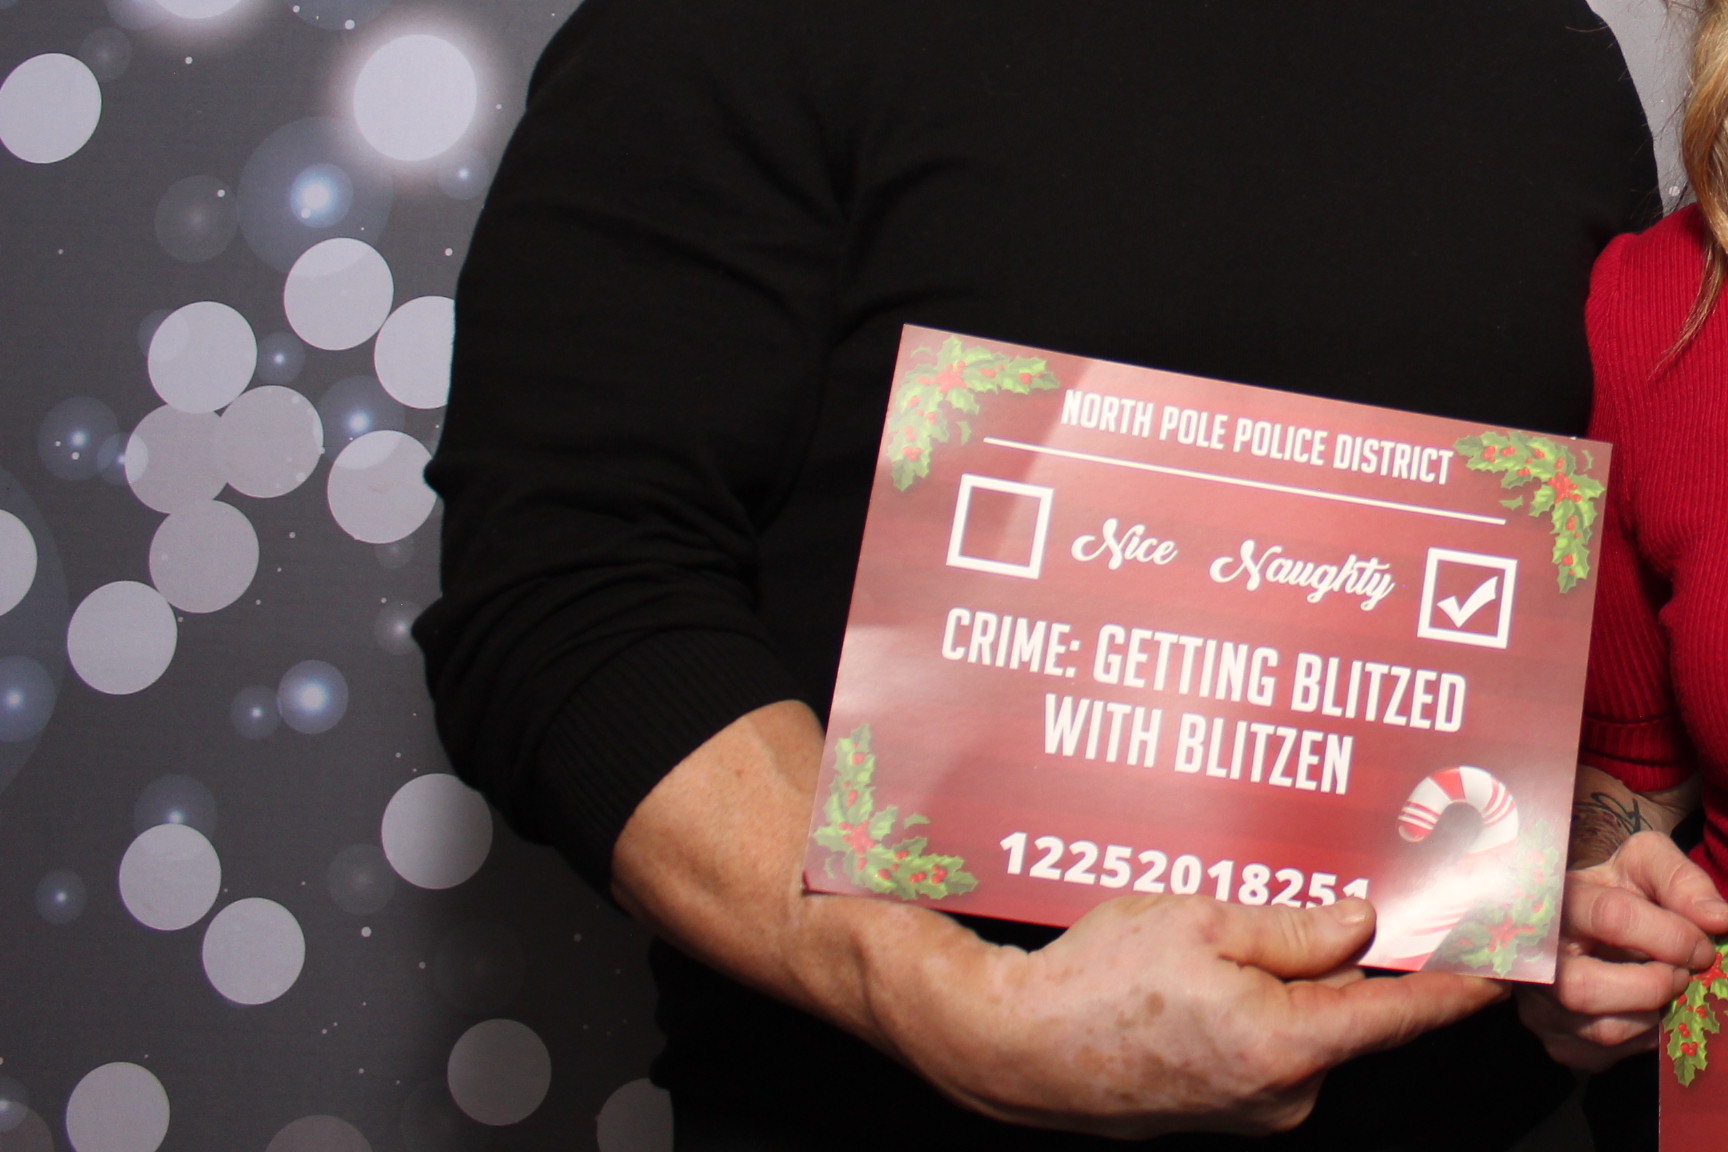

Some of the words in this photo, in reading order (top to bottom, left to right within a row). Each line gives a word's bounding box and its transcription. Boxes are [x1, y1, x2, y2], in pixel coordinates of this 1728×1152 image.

[1061, 389, 1154, 438] NORTH
[1159, 405, 1227, 450] POLE
[1233, 417, 1328, 466] POLICE
[1333, 433, 1454, 485] DISTRICT
[1071, 518, 1178, 570] Nice
[1209, 539, 1395, 611] Naughty
[942, 607, 1080, 678] CRIME:
[1093, 624, 1278, 706] GETTING
[1291, 653, 1466, 732] BLITZED
[1045, 693, 1163, 768] WITH
[1174, 712, 1354, 795] BLITZEN
